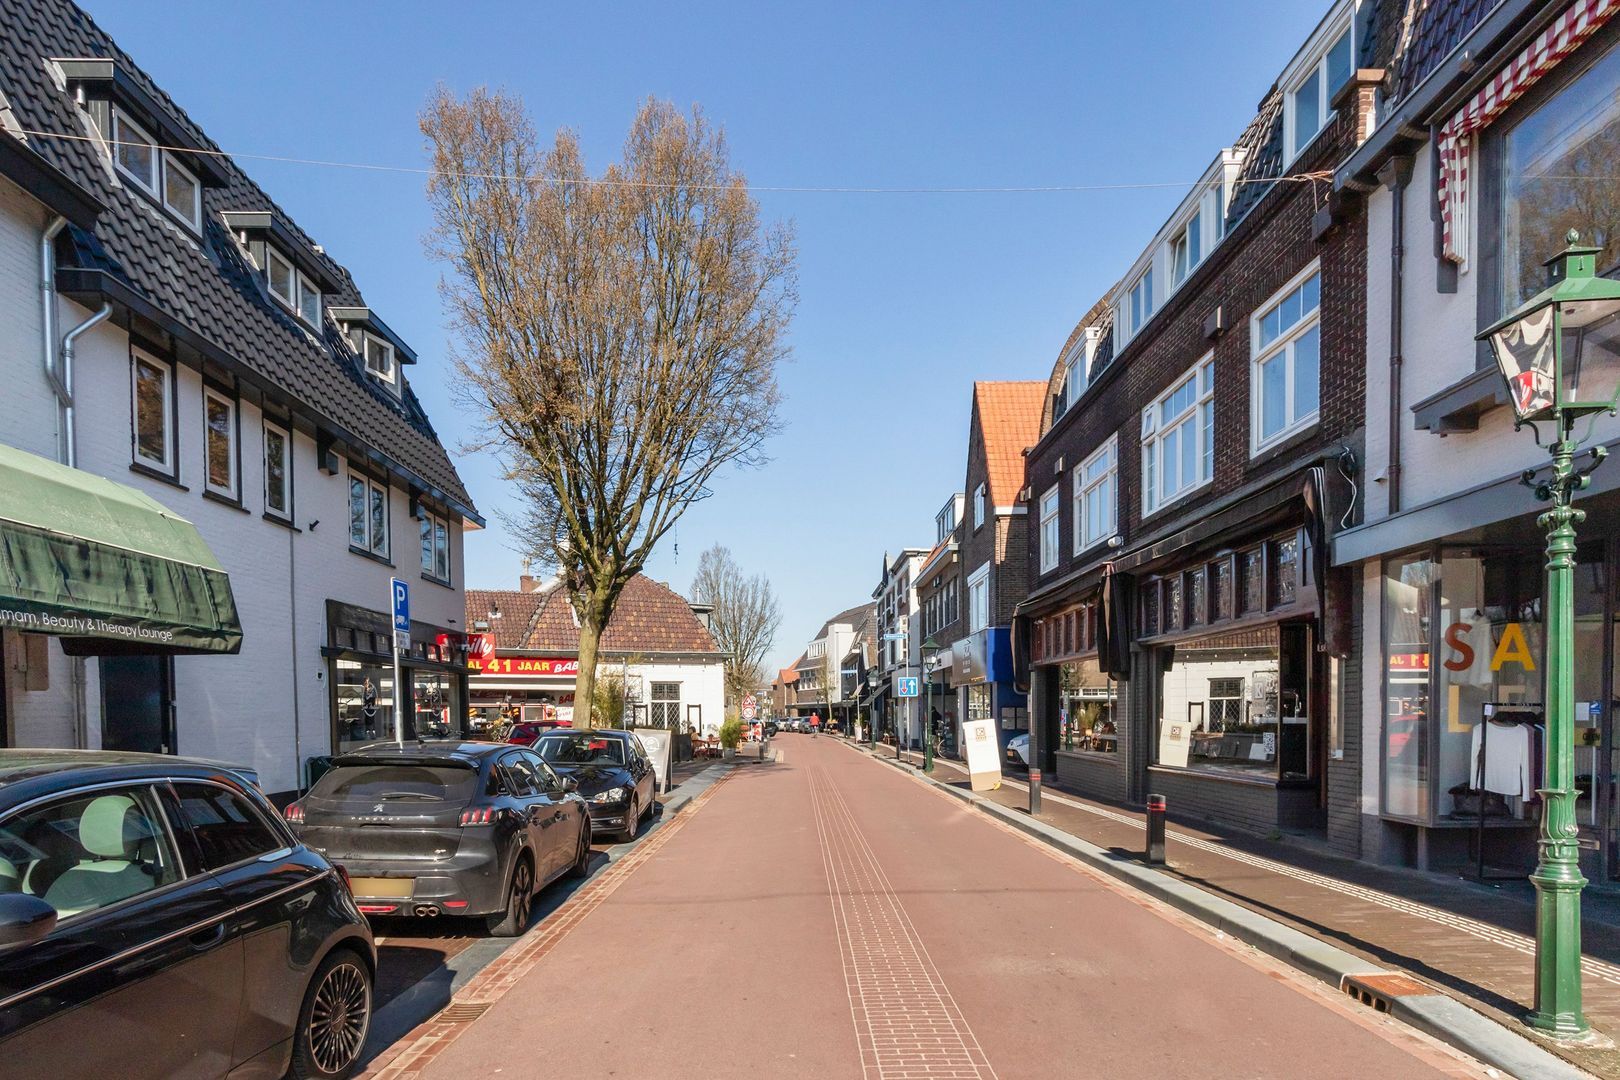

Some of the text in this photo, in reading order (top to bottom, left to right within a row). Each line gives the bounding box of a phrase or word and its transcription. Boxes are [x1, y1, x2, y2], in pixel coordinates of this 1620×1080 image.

[396, 585, 406, 610] P
[42, 612, 86, 632] Beauty
[87, 618, 96, 631] &
[95, 619, 138, 638] Therapy
[137, 625, 173, 642] Lounge
[487, 659, 511, 672] 41
[517, 661, 550, 671] JAAR
